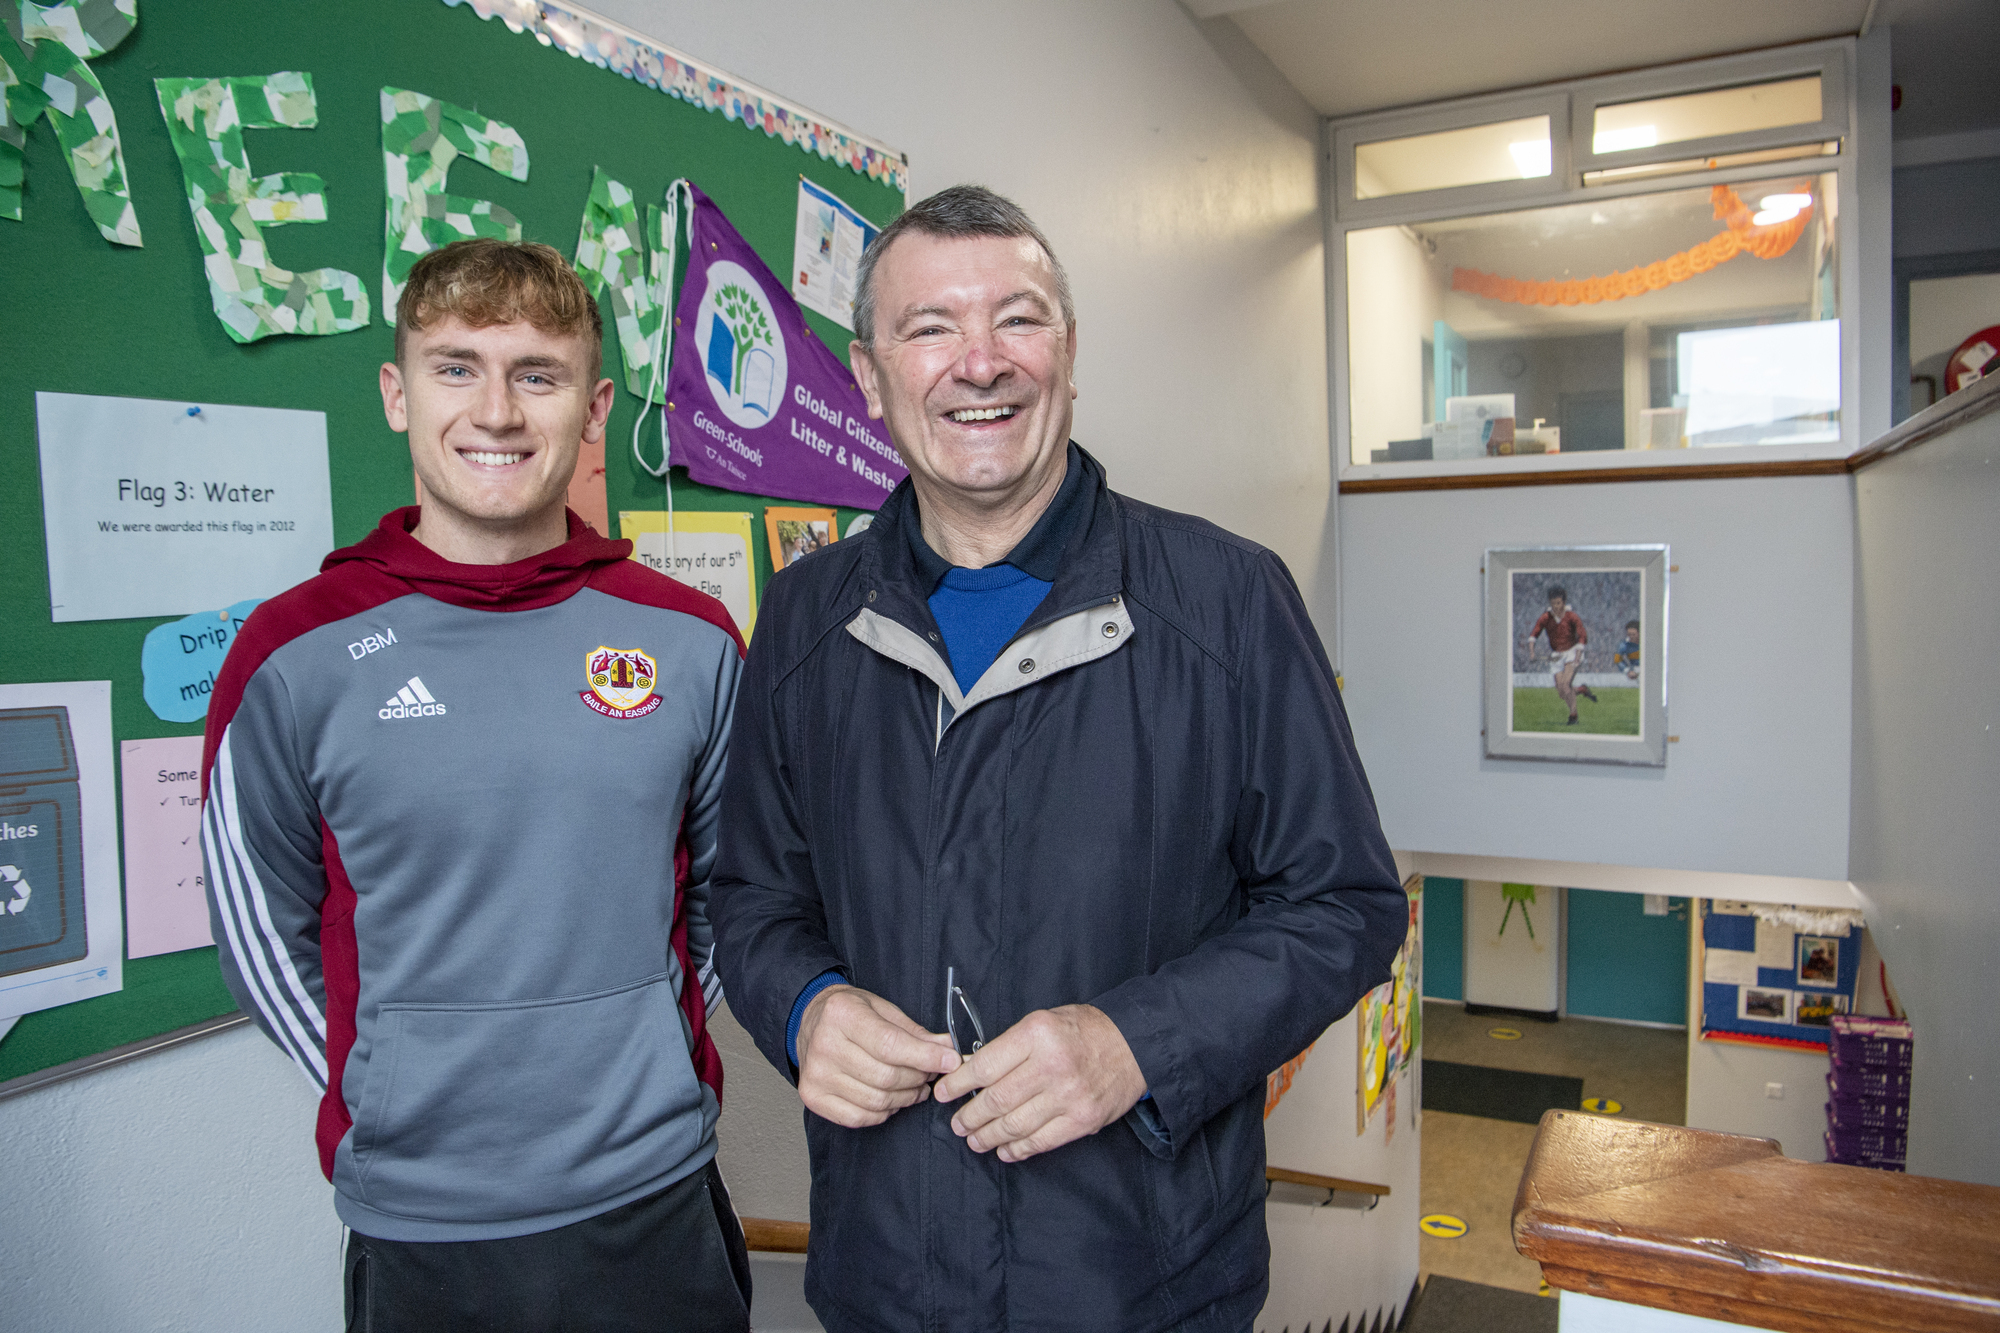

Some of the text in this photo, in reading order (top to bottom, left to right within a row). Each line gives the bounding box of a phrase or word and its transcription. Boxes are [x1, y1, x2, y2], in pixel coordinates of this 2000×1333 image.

[793, 384, 842, 429] Global
[693, 410, 763, 468] Green-Schools
[716, 455, 727, 468] An
[791, 417, 896, 493] Litter & Waste
[118, 478, 275, 507] Flag 3: Water
[97, 520, 295, 535] We were awarded this flag in 2012
[641, 550, 743, 572] The sory of our 5th
[700, 580, 722, 599] Flag
[180, 626, 228, 654] Drip
[347, 627, 399, 660] DBM
[378, 702, 447, 720] adidas
[583, 693, 661, 718] BAILE AN EASPAIG
[157, 769, 198, 783] Some
